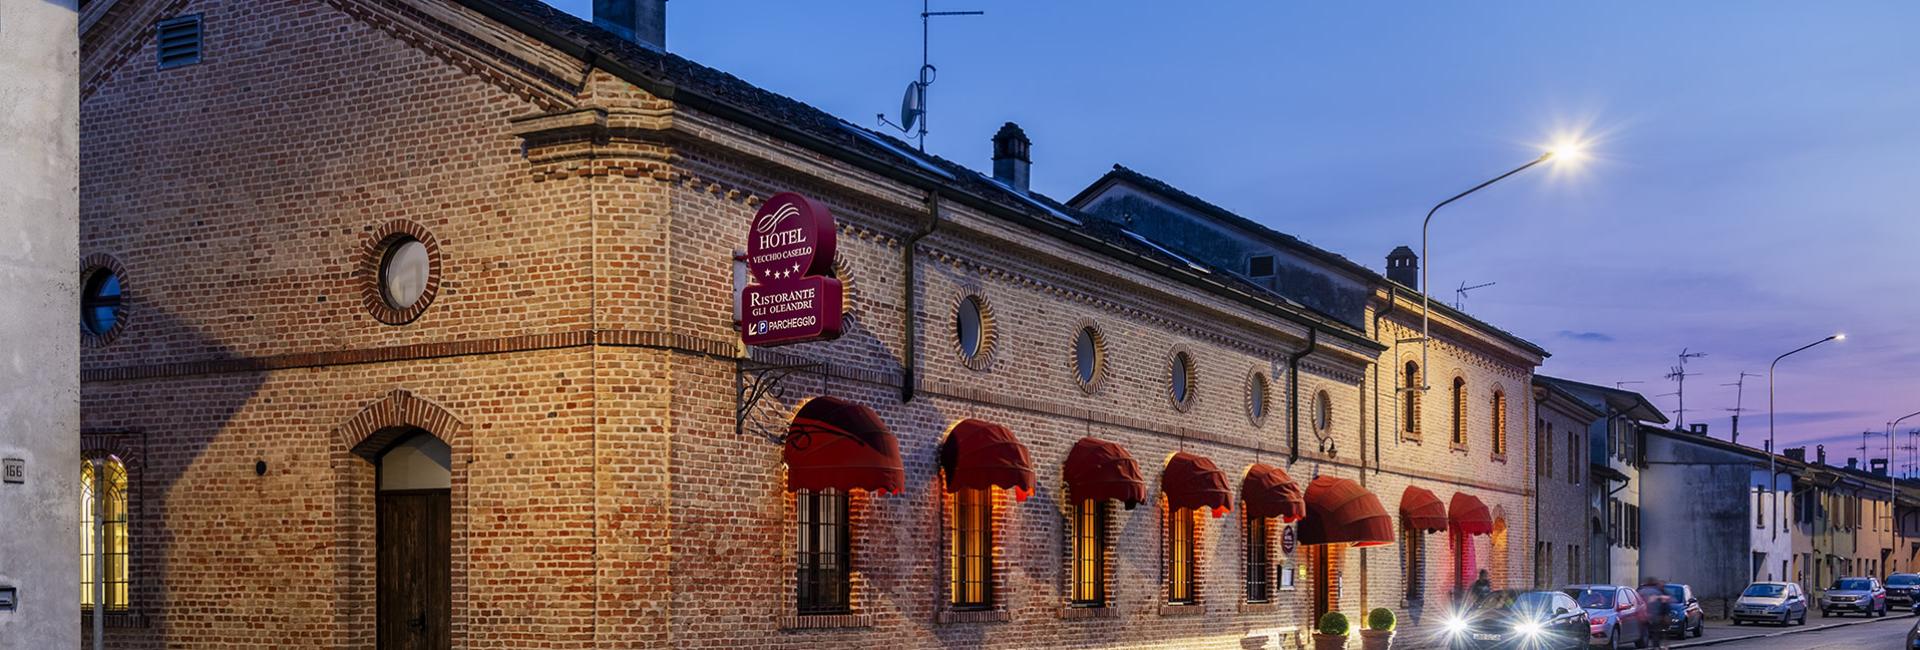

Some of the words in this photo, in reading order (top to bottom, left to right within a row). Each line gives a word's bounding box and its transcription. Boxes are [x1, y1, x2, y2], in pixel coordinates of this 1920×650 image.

[760, 228, 807, 250] HOTEL
[753, 253, 782, 264] VECCHIO
[782, 246, 812, 261] CASELLO
[750, 288, 815, 307] RISTORANTE
[752, 307, 766, 316] GLI
[769, 300, 812, 314] OLEANDRI
[768, 315, 816, 331] PARCHEGGIO
[6, 464, 22, 477] 166
